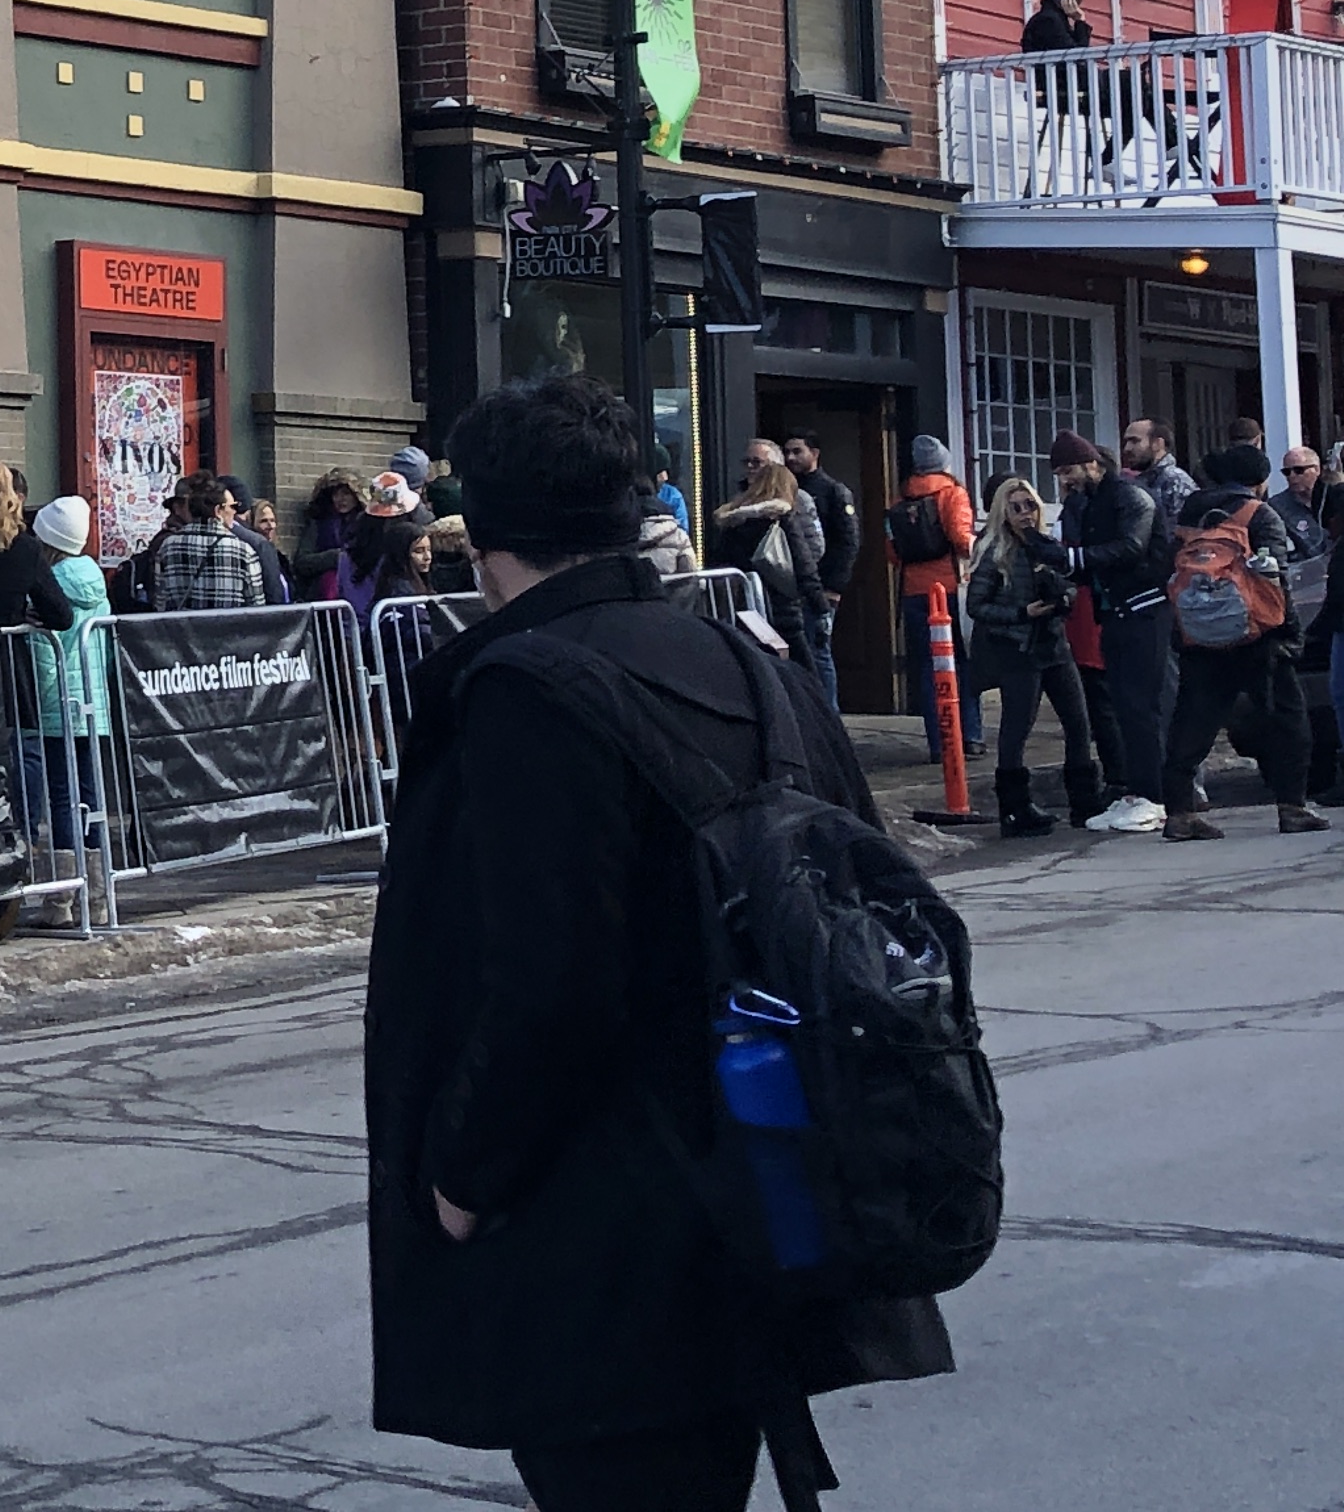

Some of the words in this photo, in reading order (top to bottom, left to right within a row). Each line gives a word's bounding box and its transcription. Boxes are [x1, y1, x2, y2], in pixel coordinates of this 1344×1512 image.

[515, 233, 606, 259] BEAUTY
[104, 258, 201, 289] EGYPTIAN
[515, 256, 605, 277] BOUTIQUE
[109, 282, 197, 312] THEATRE
[93, 346, 192, 378] UNDANCE
[138, 662, 220, 696] sundance
[221, 655, 257, 691] film
[255, 648, 311, 687] festival
